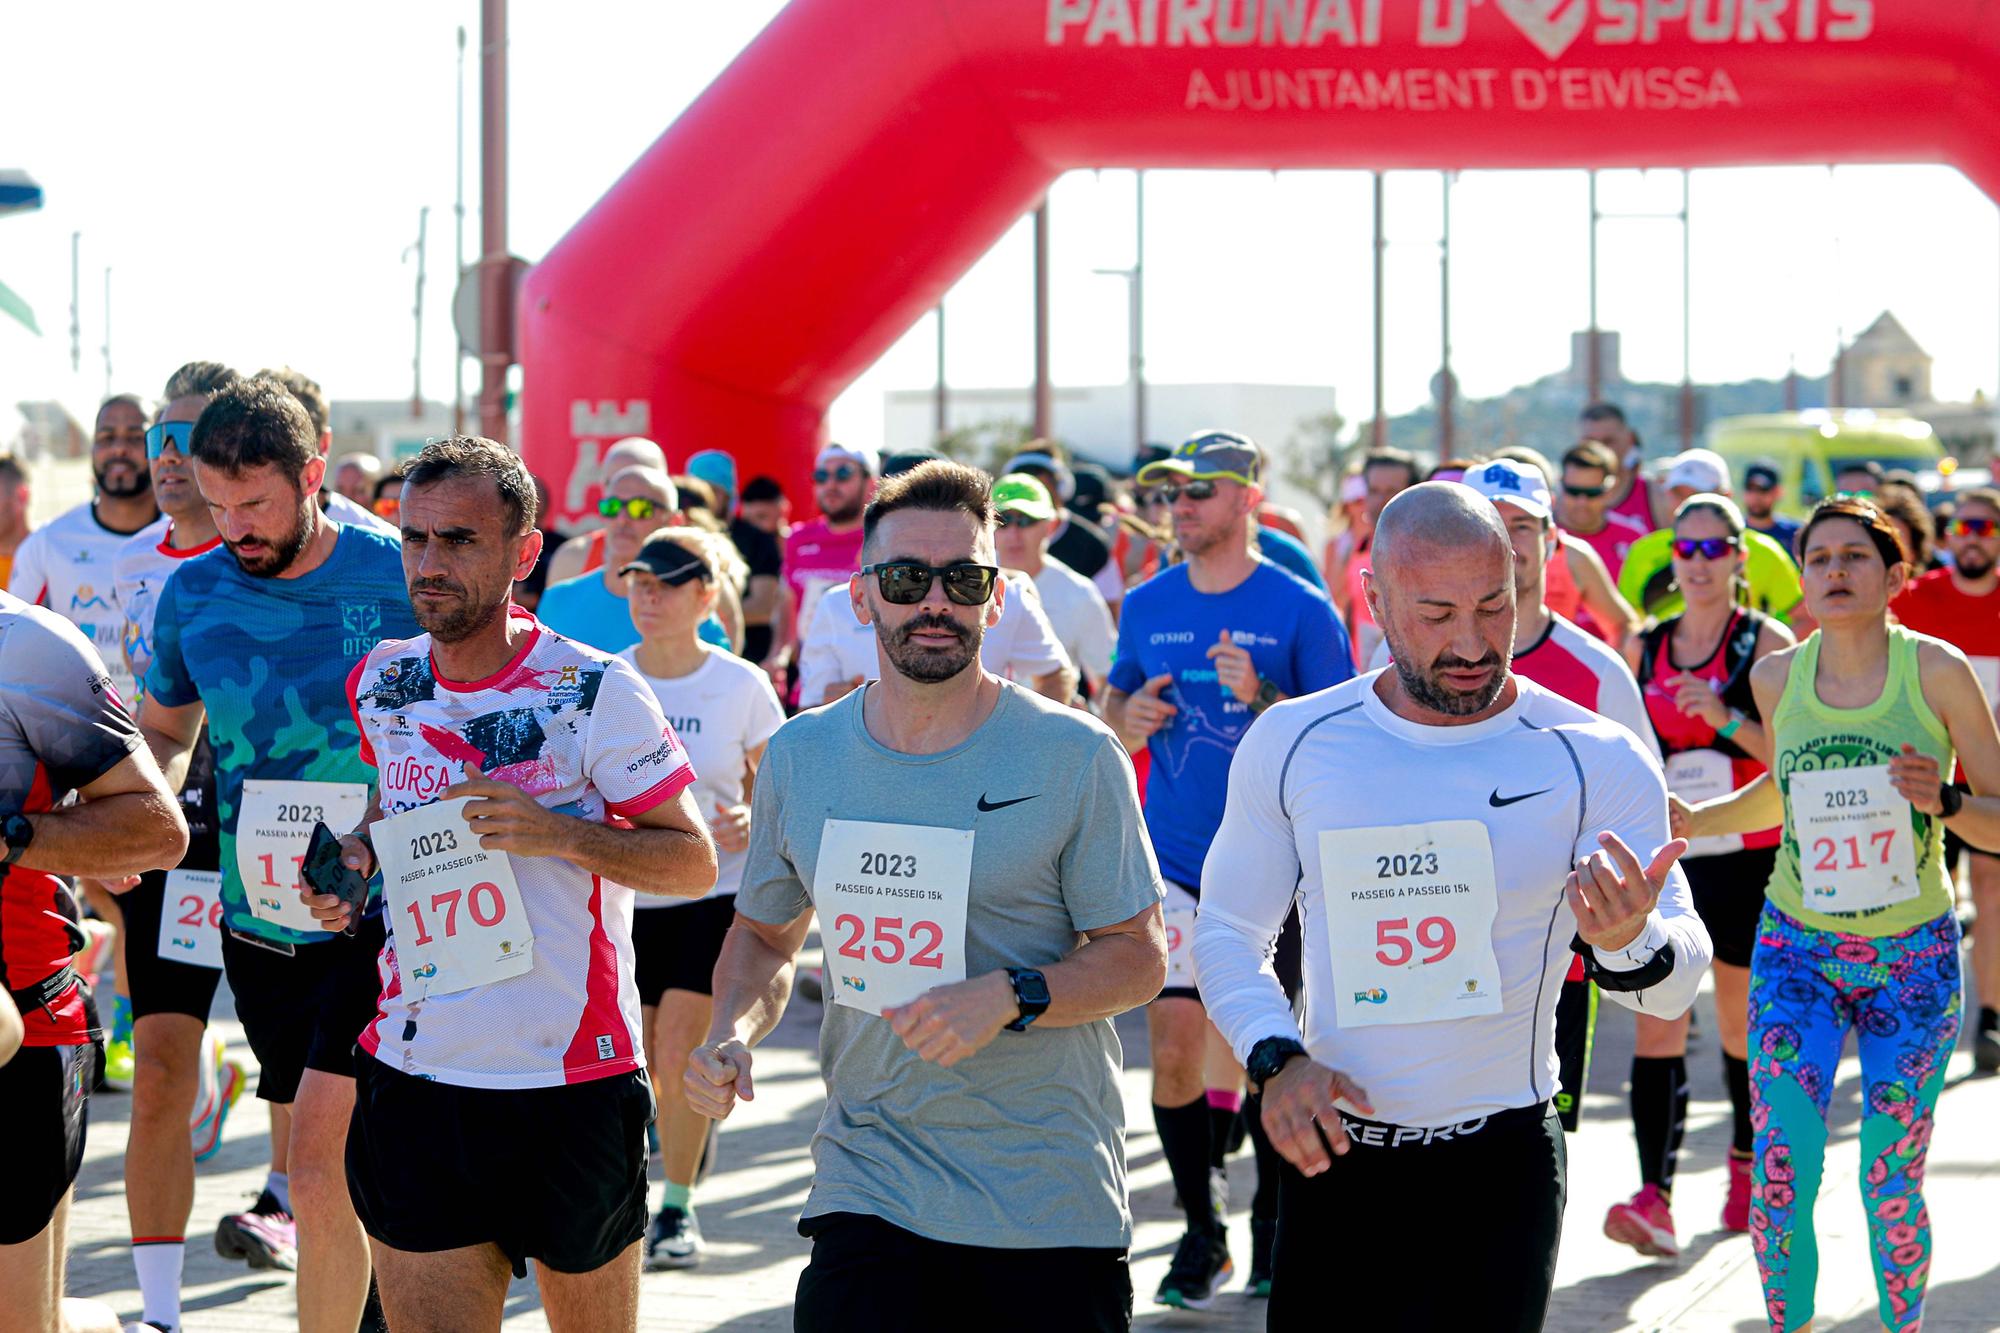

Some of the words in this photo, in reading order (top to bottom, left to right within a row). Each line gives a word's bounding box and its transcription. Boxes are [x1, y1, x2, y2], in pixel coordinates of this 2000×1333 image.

[1184, 67, 1499, 111] AJUNTAMENT
[1510, 66, 1742, 110] D'EIVISSA
[1831, 734, 1872, 747] POWER
[387, 756, 450, 799] CURSA
[627, 763, 638, 773] 10
[277, 804, 325, 823] 2023
[1824, 789, 1869, 808] 2023
[411, 829, 458, 860] 2023
[1813, 828, 1896, 872] 217
[400, 869, 427, 885] PASSEIG
[427, 866, 434, 876] A
[436, 857, 473, 874] PASSEIG
[474, 852, 489, 862] 15k
[860, 852, 917, 878] 2023
[1376, 852, 1439, 878] 2023
[835, 883, 874, 895] PASSEIG
[876, 888, 883, 896] A
[885, 889, 925, 900] PASSEIG
[928, 891, 943, 901] 15k
[1351, 889, 1395, 900] PASSEIG
[1398, 889, 1405, 897] A
[1407, 885, 1451, 897] PASSEIG
[1454, 883, 1471, 894] 15k
[406, 881, 507, 947] 170
[834, 913, 944, 970] 252
[1375, 916, 1457, 967] 59
[1338, 1116, 1389, 1147] KE
[1391, 1115, 1488, 1147] PRO
